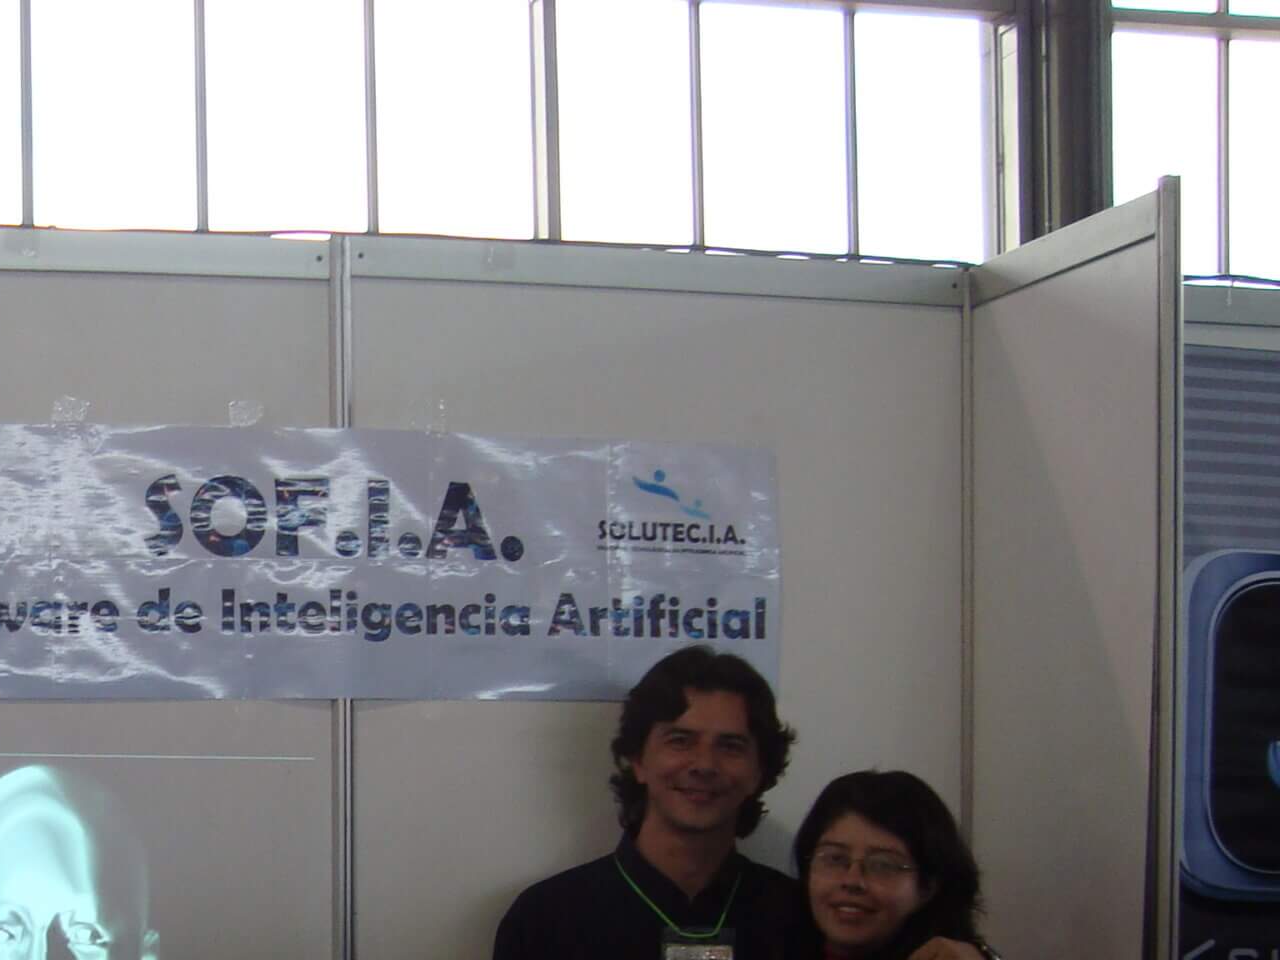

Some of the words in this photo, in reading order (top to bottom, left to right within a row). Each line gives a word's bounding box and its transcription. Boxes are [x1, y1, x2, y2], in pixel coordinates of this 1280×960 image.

[143, 473, 524, 562] SOF.I.A.
[598, 520, 746, 545] SOLUTEC.I.A.
[136, 587, 204, 634] de
[221, 588, 530, 642] Inteligencia
[548, 592, 767, 640] Artificial
